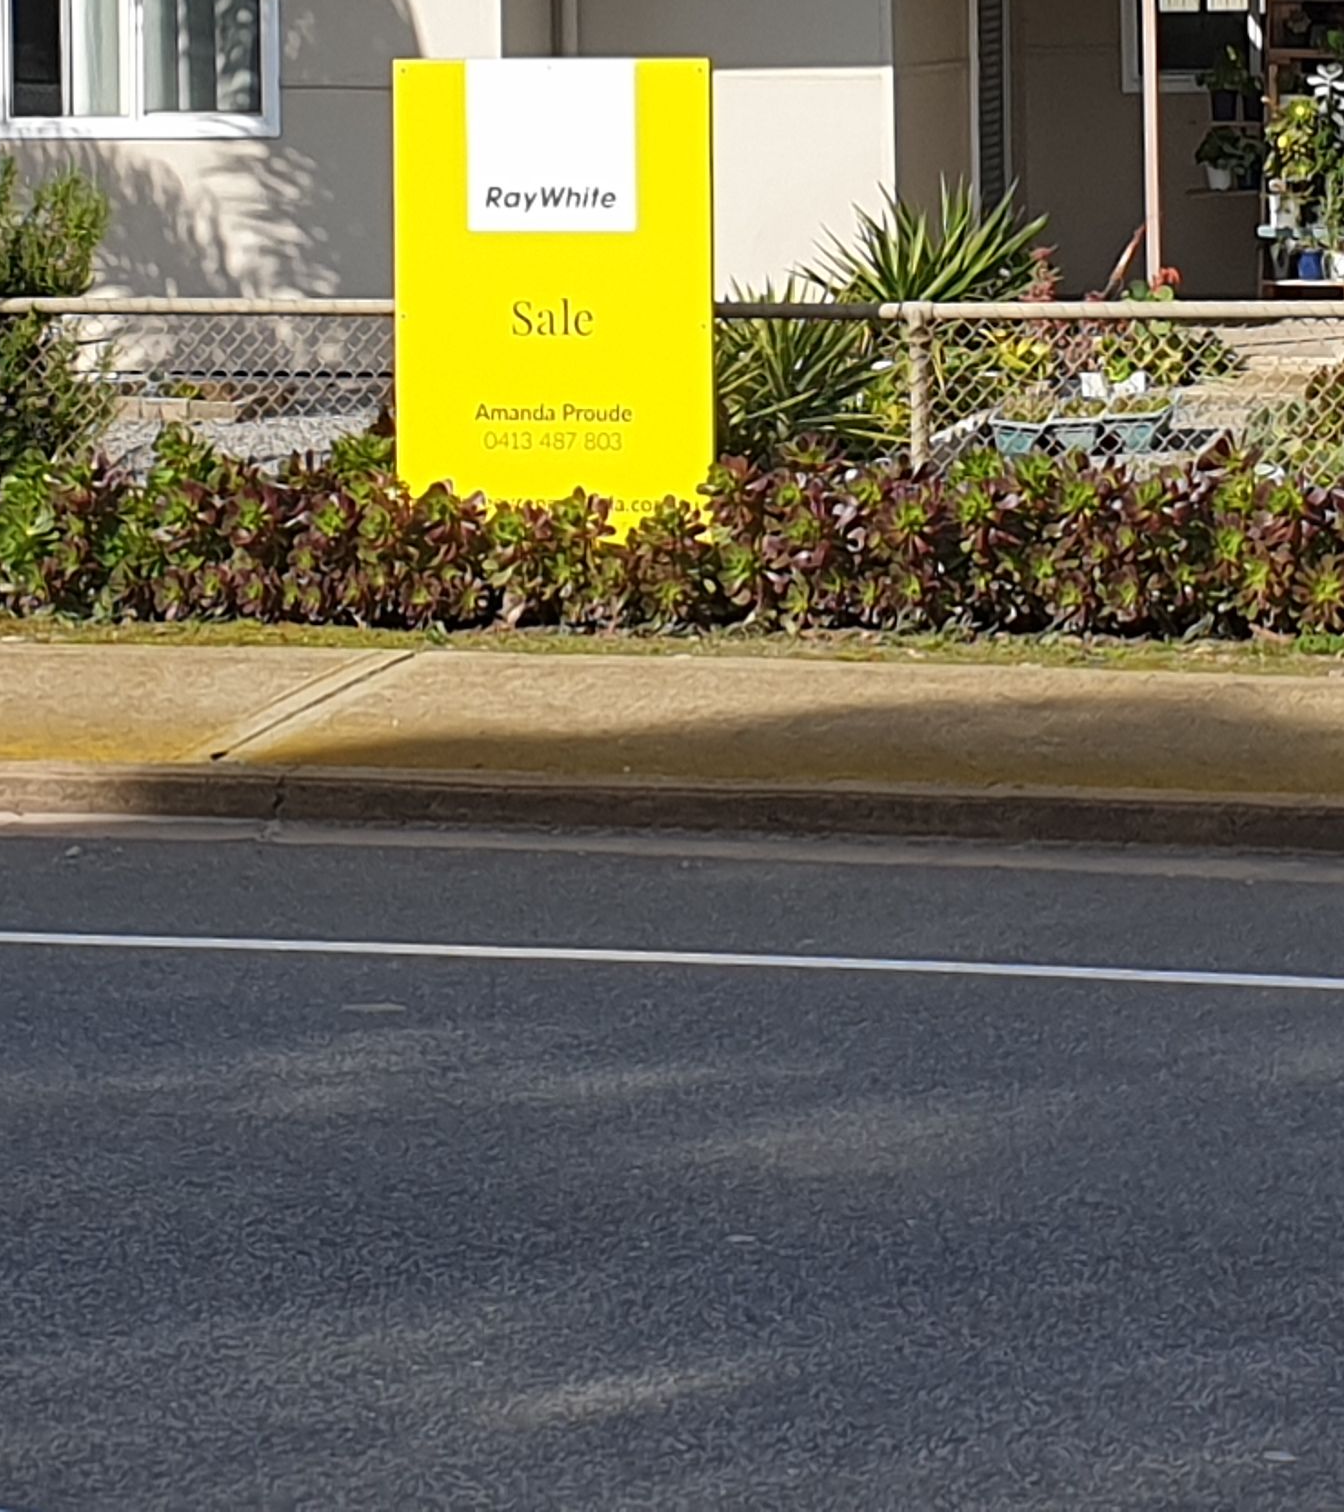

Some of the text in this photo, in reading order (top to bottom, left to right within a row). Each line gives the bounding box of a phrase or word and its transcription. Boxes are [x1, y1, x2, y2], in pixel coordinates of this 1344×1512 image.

[485, 186, 617, 213] RayWhite
[512, 297, 593, 336] Sale
[475, 403, 633, 422] Amanda Proude
[483, 431, 622, 451] 0413 487 803
